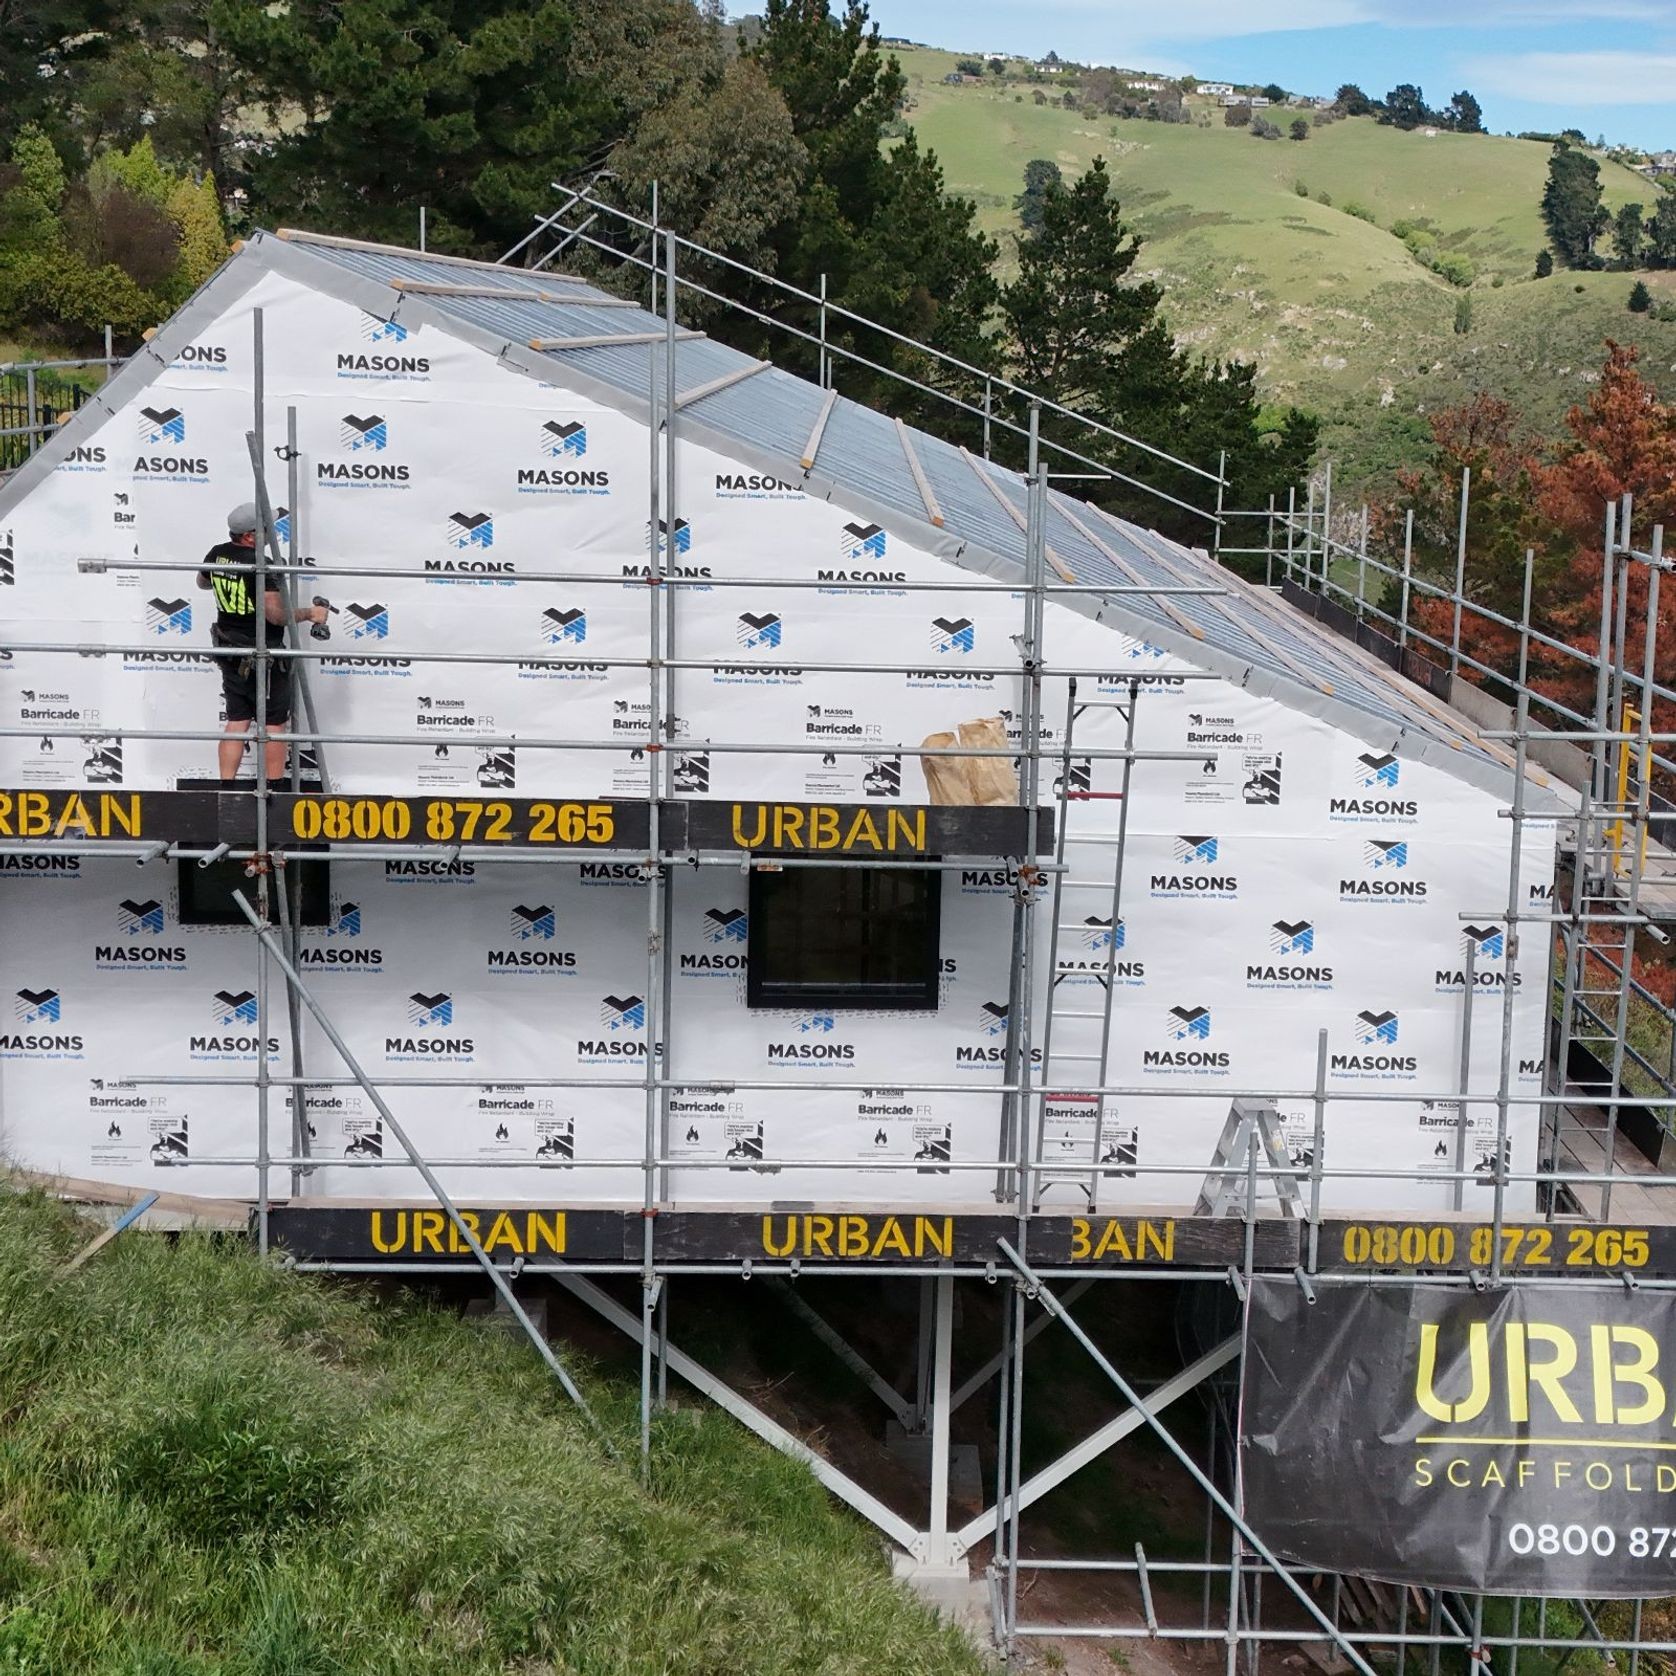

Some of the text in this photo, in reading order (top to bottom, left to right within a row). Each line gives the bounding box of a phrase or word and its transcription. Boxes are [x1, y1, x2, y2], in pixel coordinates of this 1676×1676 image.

[175, 346, 226, 362] ONS
[338, 354, 429, 371] MASONS
[134, 457, 208, 473] ASONS
[318, 463, 409, 480] MASONS
[518, 470, 609, 485] MASONS
[425, 561, 515, 572] MASONS
[818, 570, 906, 583] MASONS
[321, 657, 411, 667] MASONS
[21, 708, 100, 720] Barricade FR
[417, 715, 494, 727] Barricade FR
[613, 719, 669, 730] Barricde
[807, 723, 881, 735] Barricade FR
[1187, 733, 1262, 743] Barricade FR
[1330, 799, 1418, 815] MASONS
[0, 793, 141, 837] RBAN
[292, 800, 614, 843] 0800 872 265
[733, 804, 926, 851] URBAN
[580, 864, 665, 880] MASOS
[1151, 876, 1237, 891] MASONS
[1340, 880, 1426, 895] MASONS
[96, 947, 186, 962] MASONS
[488, 951, 576, 966] MASONS
[1247, 966, 1333, 981] MASONS
[385, 1038, 473, 1053] MASONS
[768, 1044, 854, 1058] MASONS
[1144, 1051, 1229, 1066] MASONS
[1331, 1055, 1416, 1070] MASONS
[90, 1096, 147, 1107] Barricade
[345, 1098, 362, 1108] FR
[479, 1099, 553, 1110] Barricade FR
[670, 1102, 743, 1112] Barricade FR
[859, 1105, 932, 1115] Barricade FR
[1102, 1108, 1118, 1119] FR
[1478, 1118, 1493, 1128] FR
[371, 1211, 566, 1254] URBAN
[762, 1216, 952, 1258] URBAN
[1071, 1220, 1174, 1261] BAN
[1343, 1226, 1650, 1267] 0800 872 265
[1416, 1323, 1676, 1424] URB
[1416, 1460, 1676, 1492] SCAFFOLD
[1509, 1523, 1615, 1556] 0800
